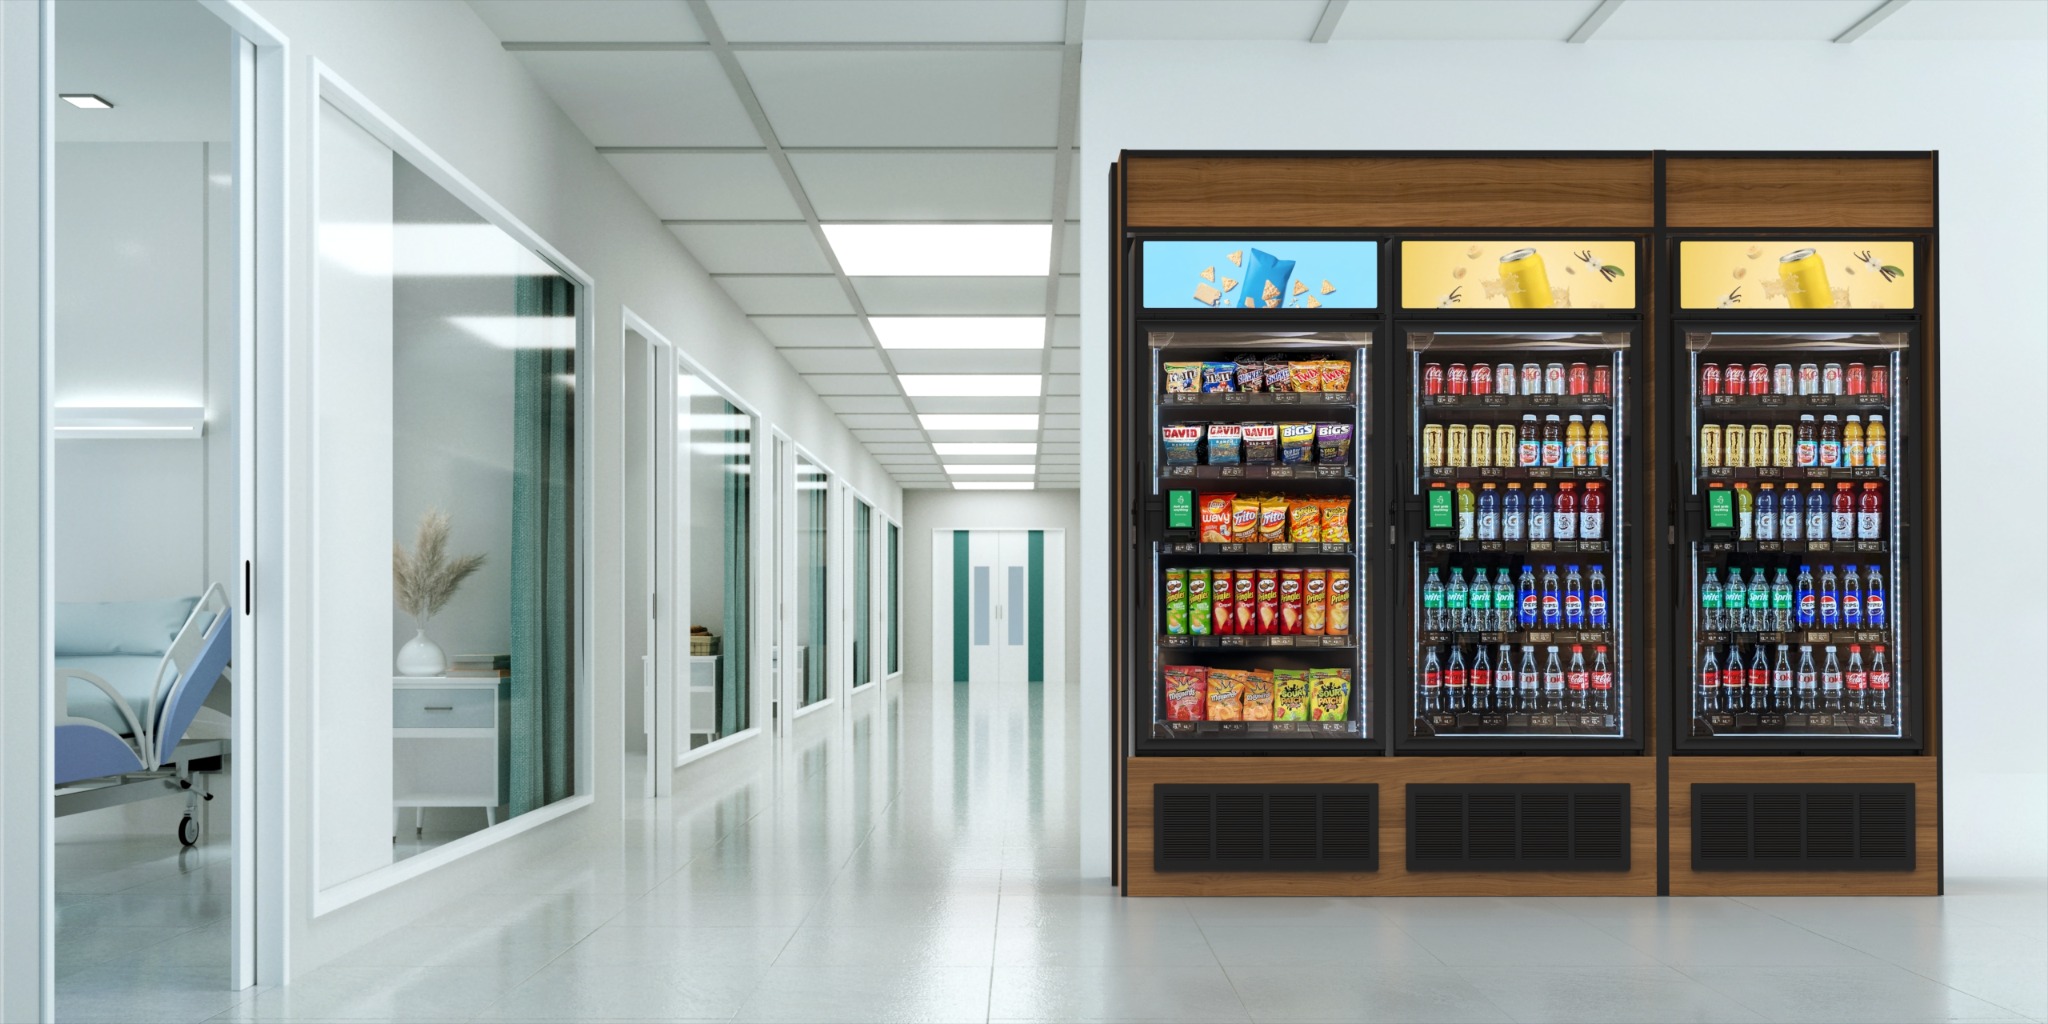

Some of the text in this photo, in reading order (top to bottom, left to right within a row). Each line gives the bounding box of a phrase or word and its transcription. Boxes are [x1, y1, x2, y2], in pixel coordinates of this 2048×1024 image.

[1237, 369, 1263, 384] SNICKER
[1164, 429, 1197, 438] DAVID
[1211, 427, 1240, 435] DAVID
[1245, 428, 1274, 437] DAVID
[1202, 512, 1230, 524] wavy
[1234, 510, 1257, 526] Frito
[1424, 592, 1441, 601] prite
[1448, 592, 1465, 601] prite
[1702, 592, 1719, 601] prite
[1726, 592, 1743, 601] prite
